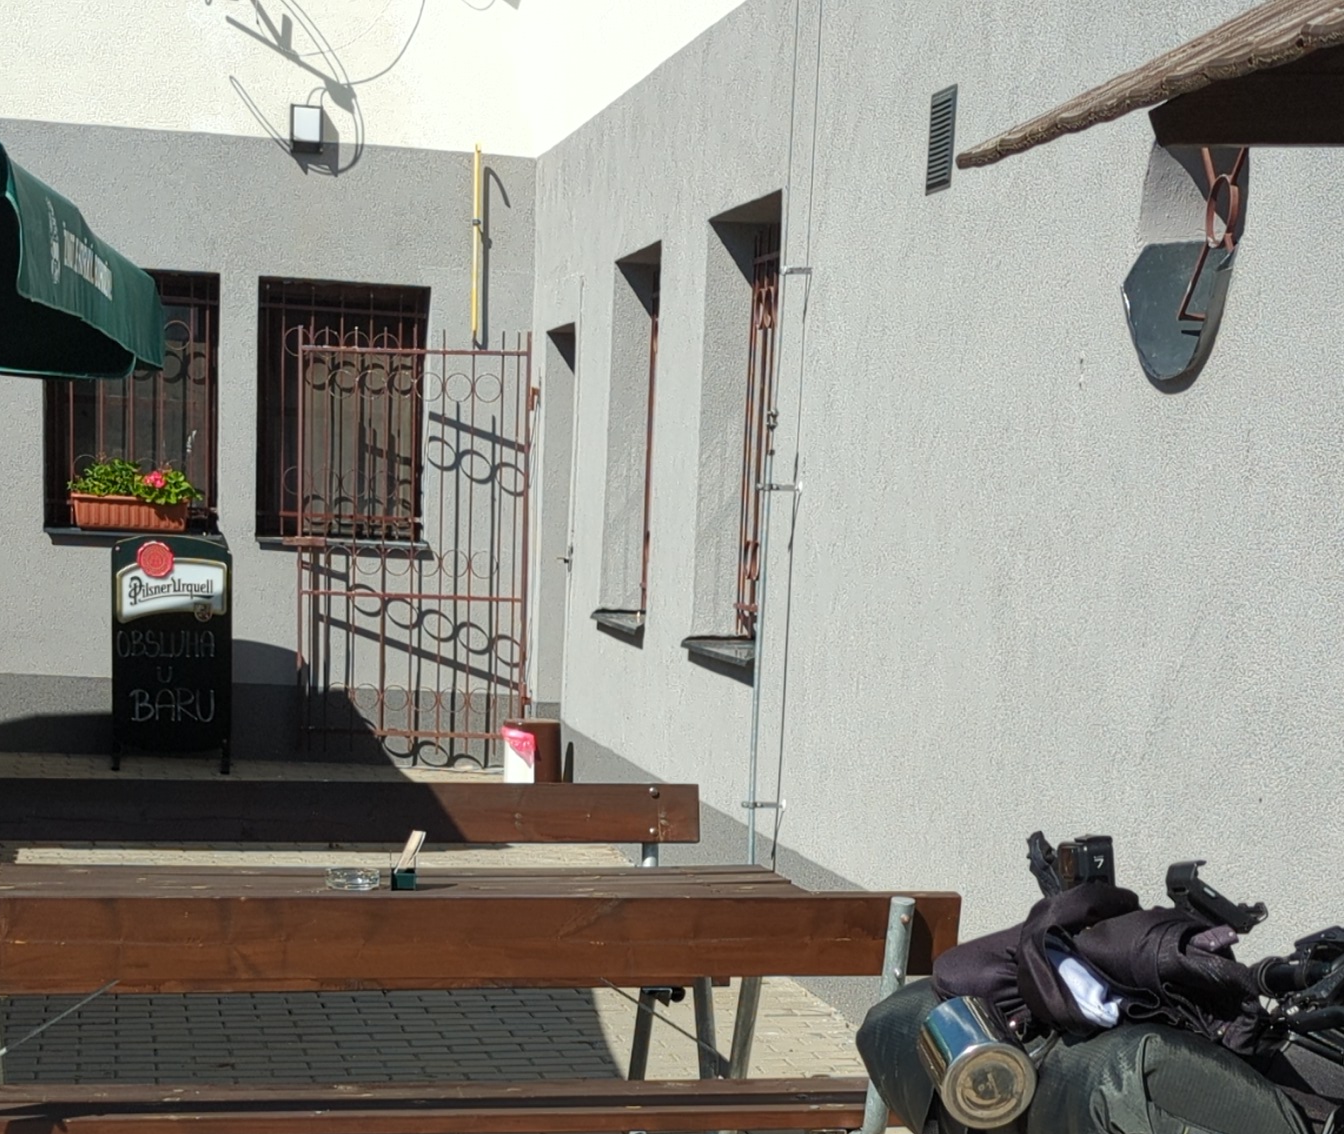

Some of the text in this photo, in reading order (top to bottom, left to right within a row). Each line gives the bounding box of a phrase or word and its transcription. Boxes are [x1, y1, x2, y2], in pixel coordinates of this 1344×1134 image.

[128, 576, 214, 605] Pilsner Urquell
[116, 629, 216, 658] OBSLUHA
[129, 688, 216, 722] BARU
